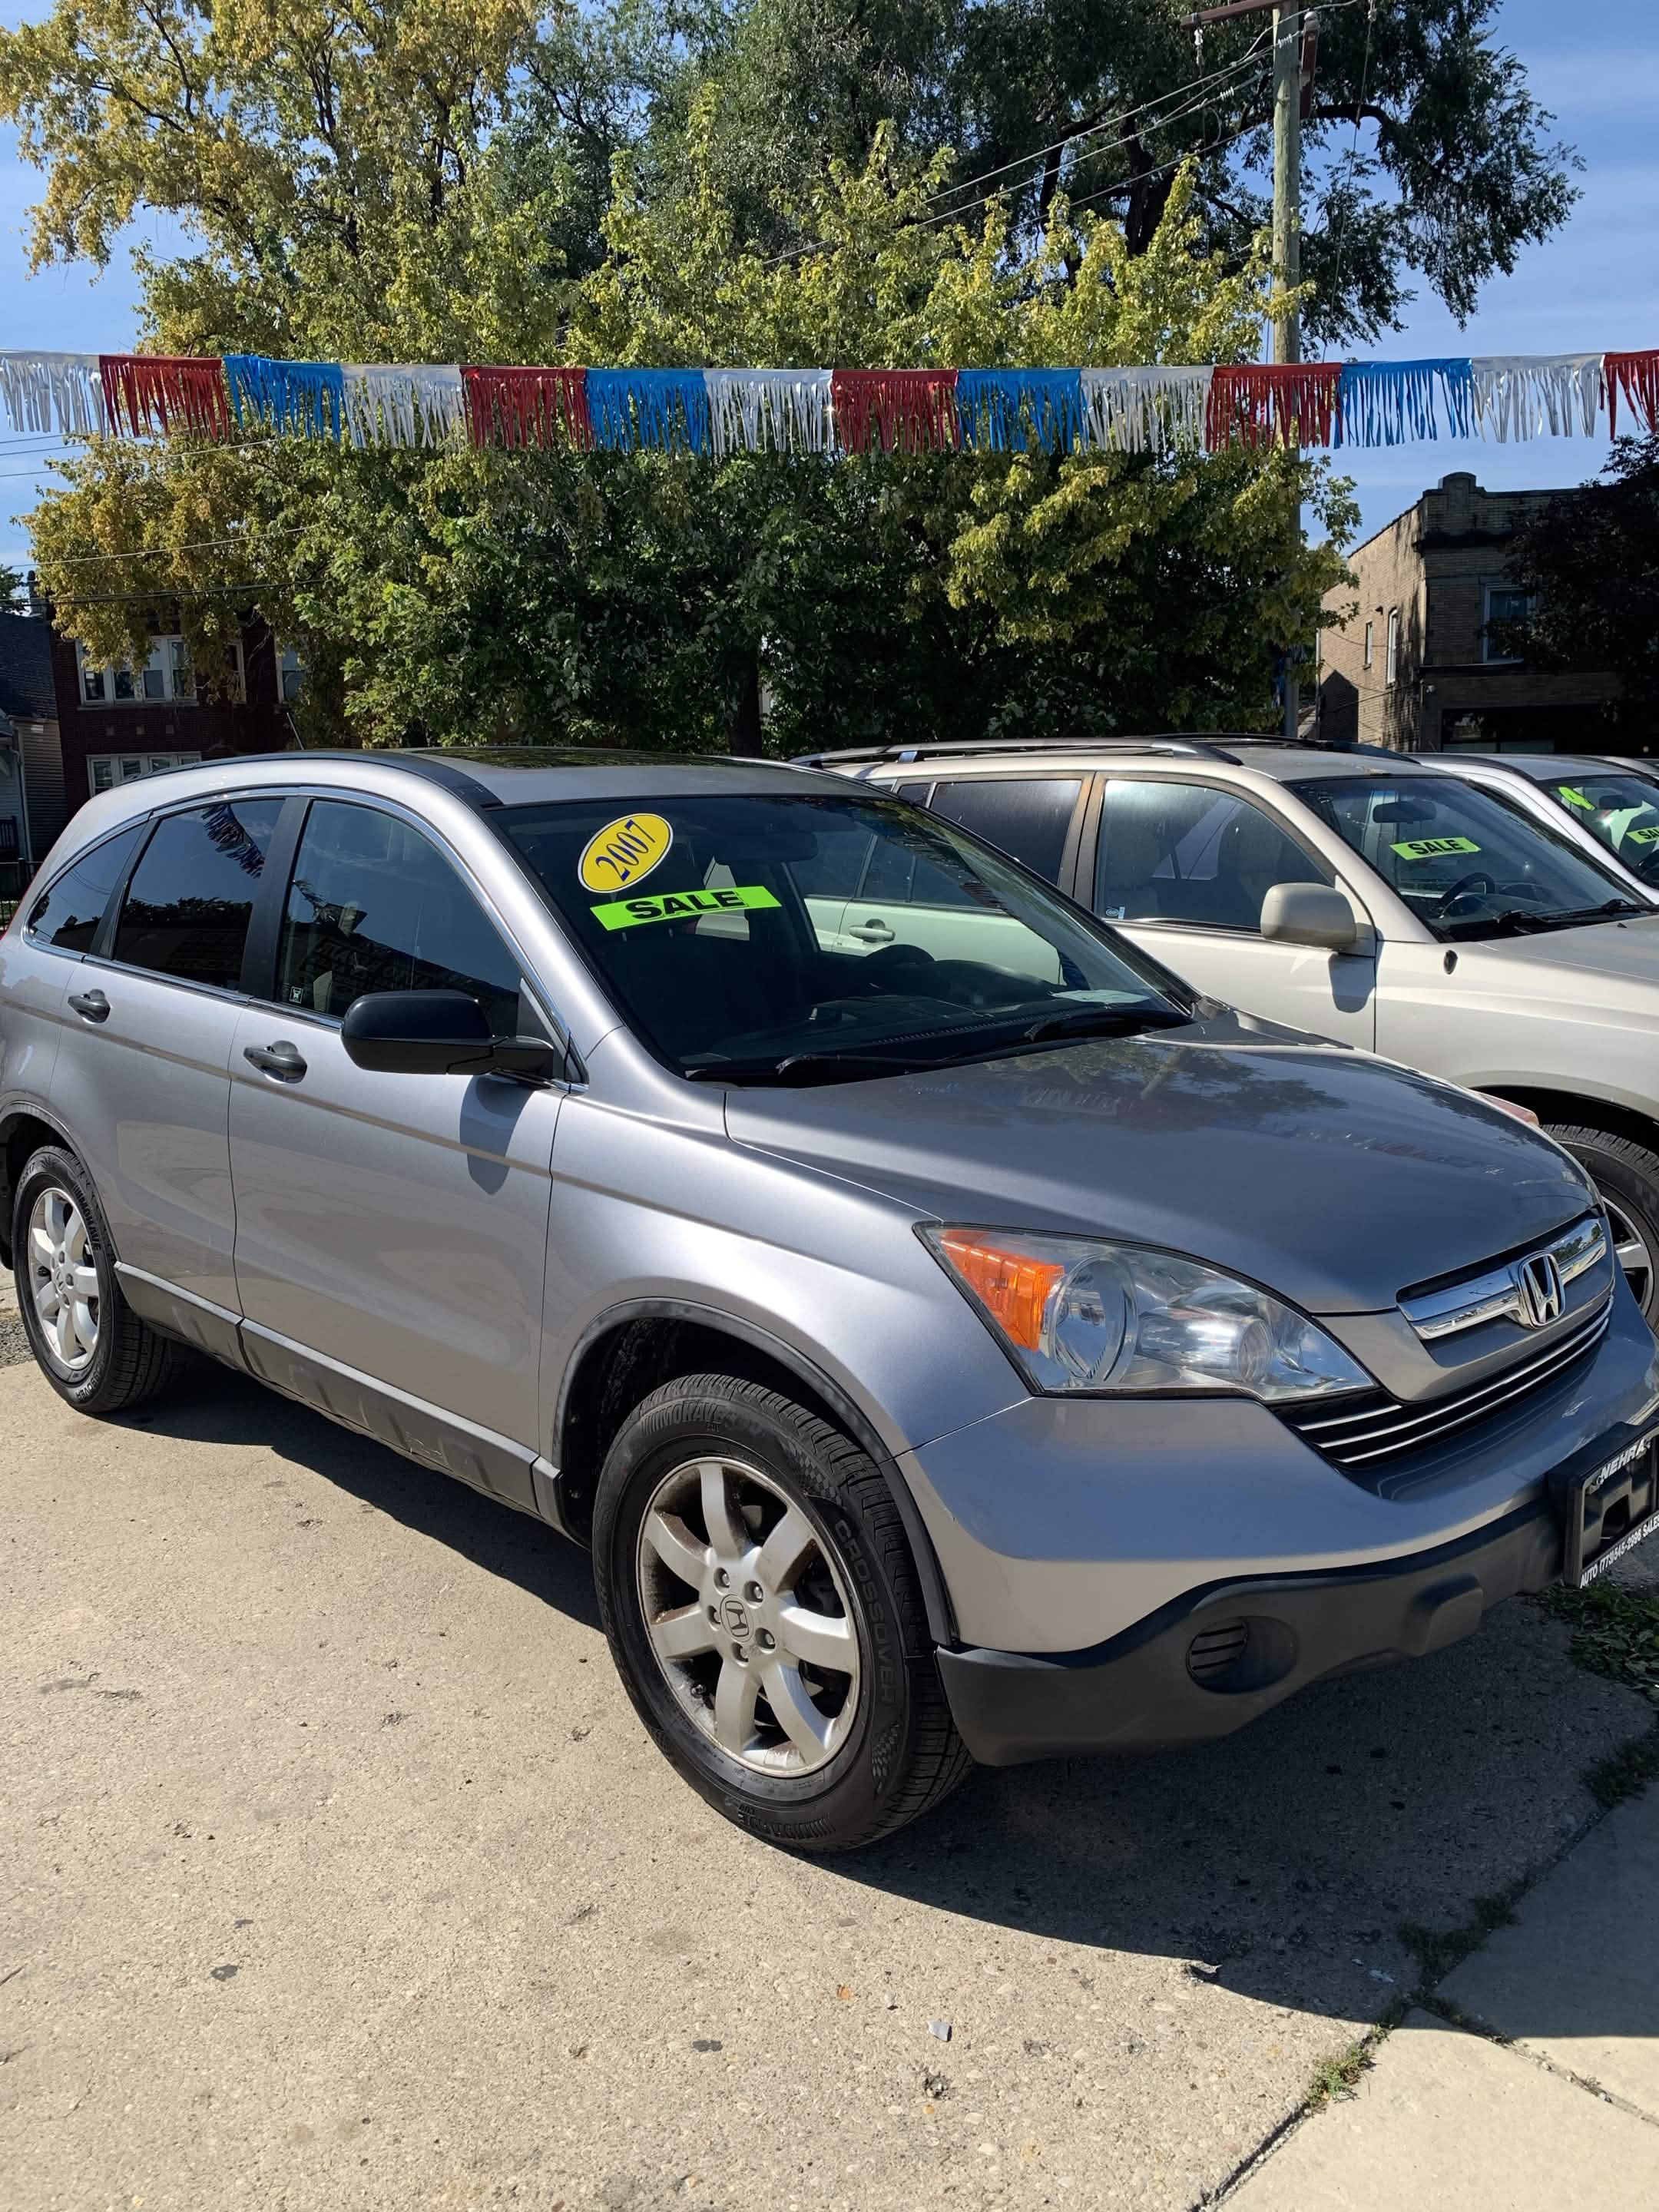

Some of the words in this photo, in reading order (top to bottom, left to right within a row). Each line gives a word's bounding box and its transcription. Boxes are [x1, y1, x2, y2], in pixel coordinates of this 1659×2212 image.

[595, 819, 656, 882] 2007
[1408, 839, 1465, 855] SALE
[626, 890, 746, 920] SALE
[1580, 1564, 1598, 1589] AUTO
[835, 1518, 893, 1705] CROSSOVER
